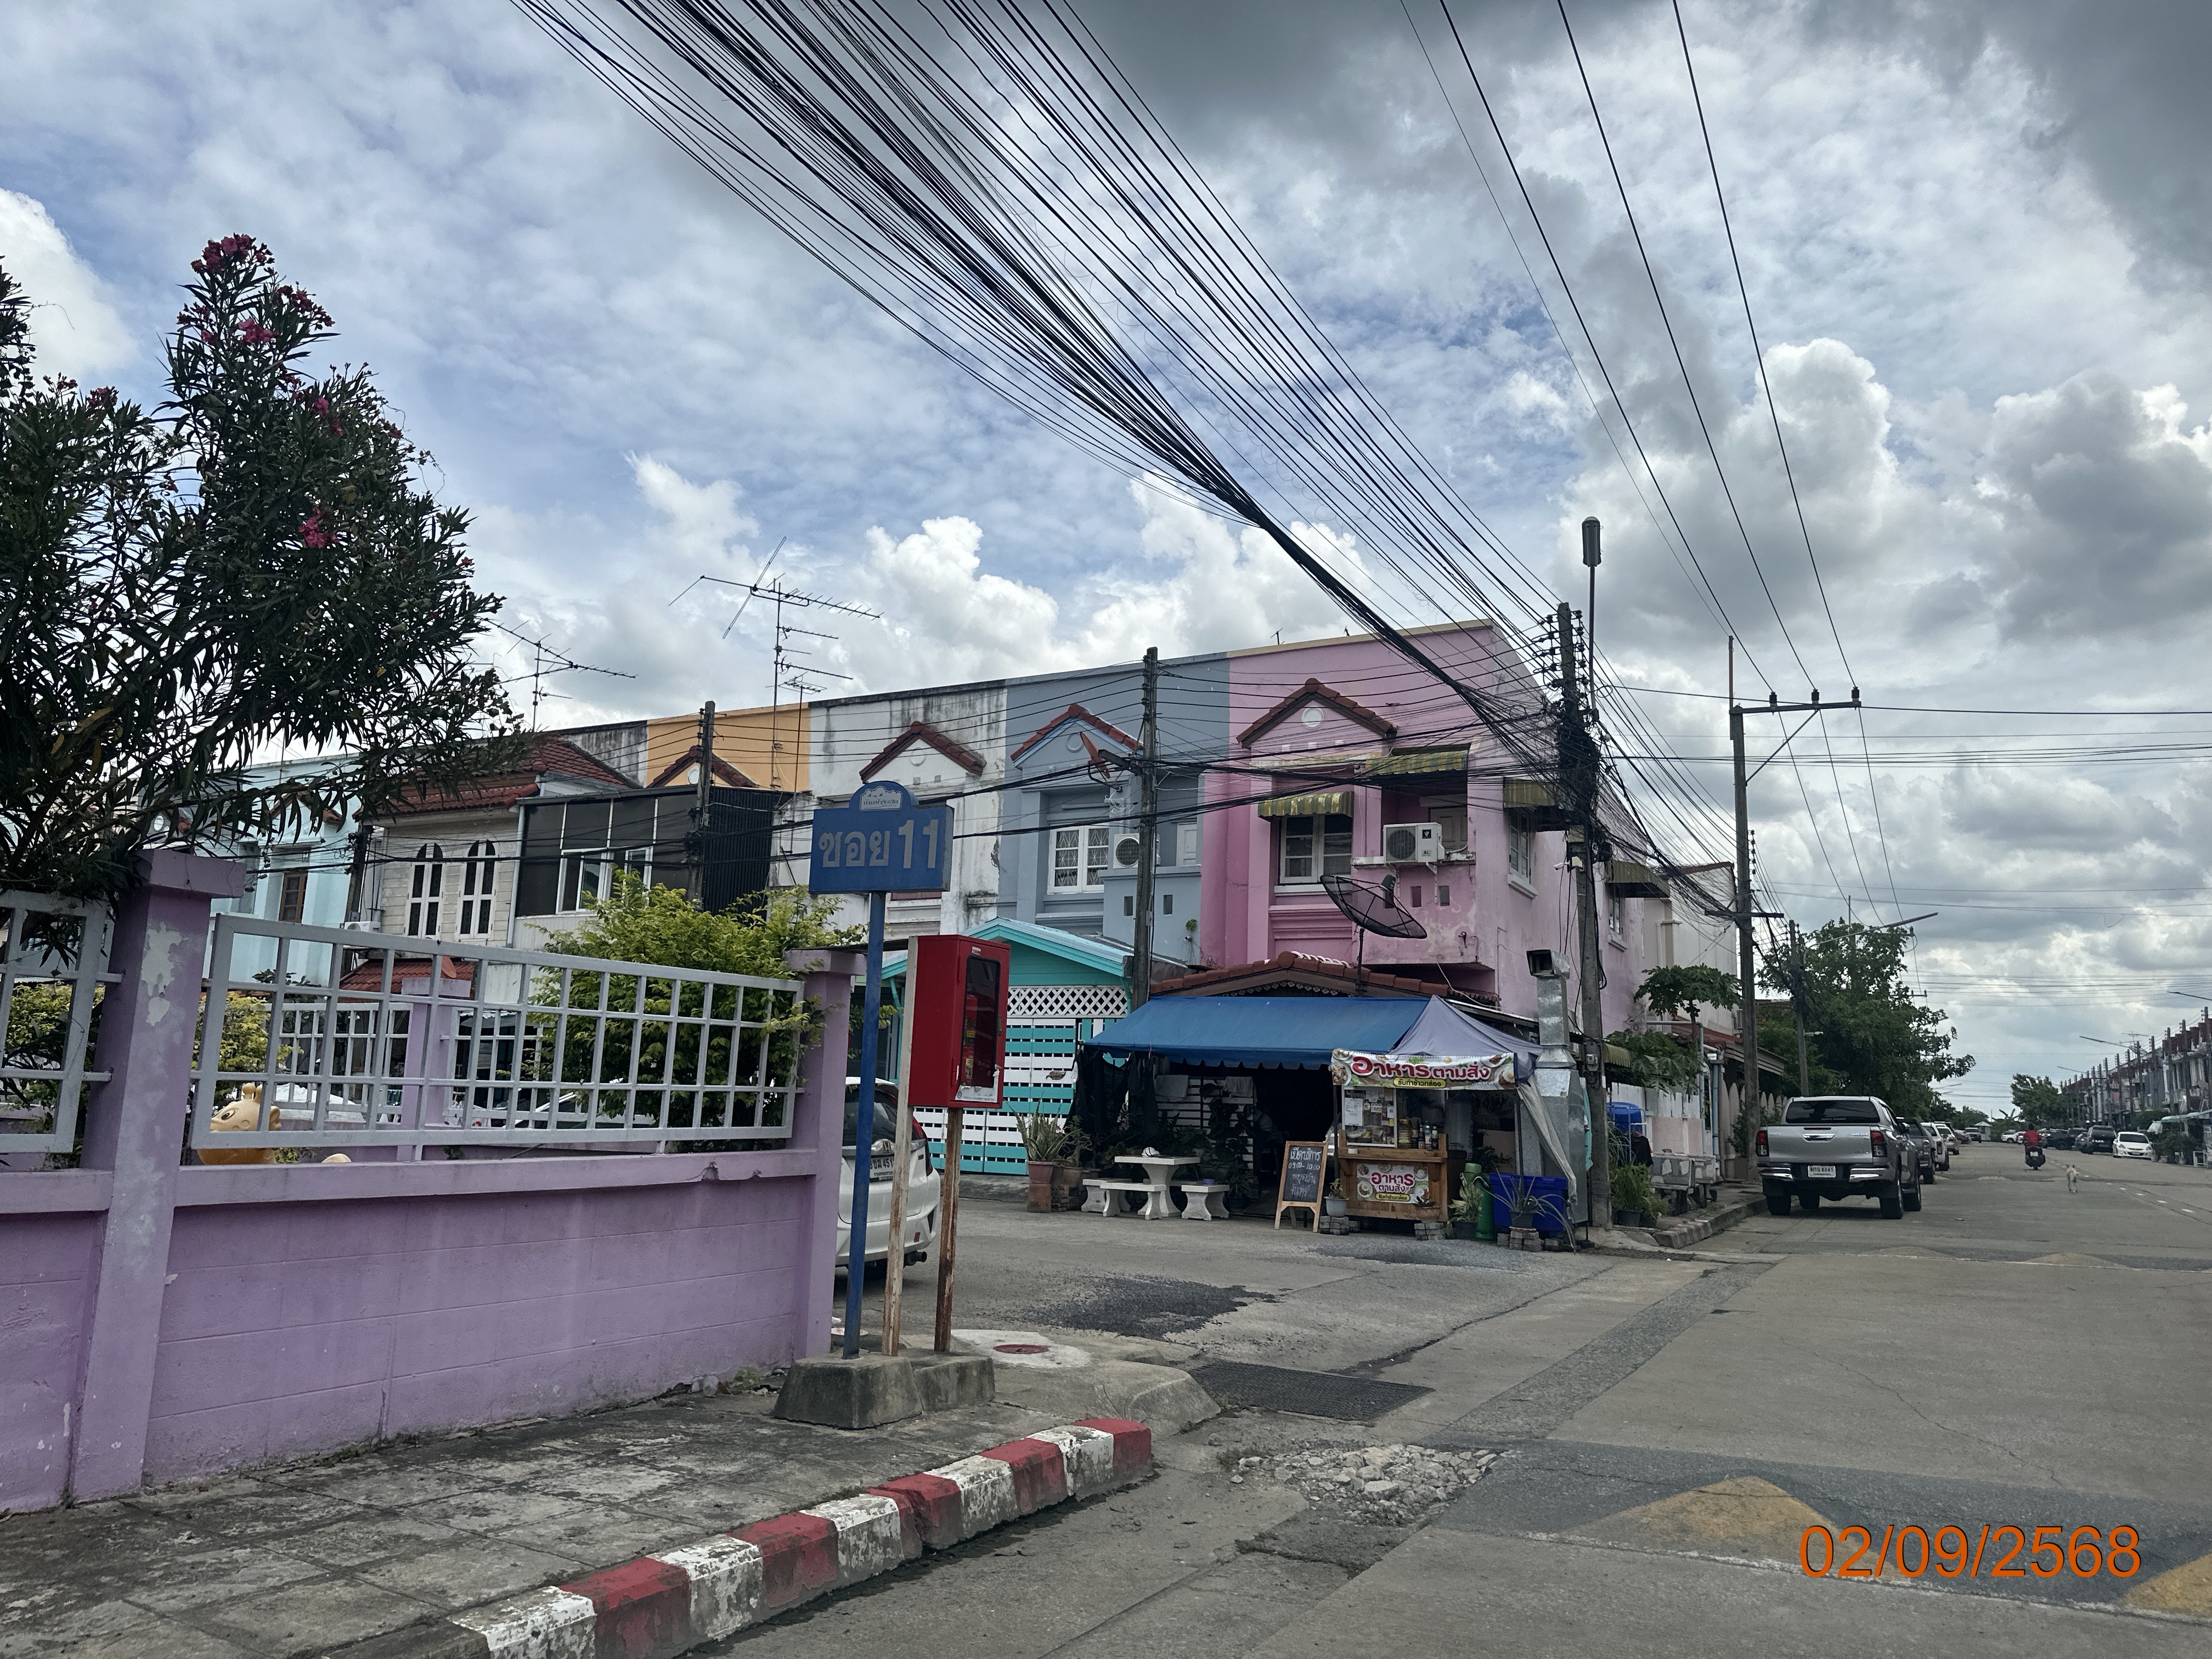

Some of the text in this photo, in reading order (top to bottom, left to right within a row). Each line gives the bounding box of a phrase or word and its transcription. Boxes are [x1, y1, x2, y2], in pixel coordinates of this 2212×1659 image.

[819, 819, 939, 869] ซอย 11
[1372, 1172, 1414, 1186] อาหาร
[1379, 1181, 1406, 1193] ตามสั่ง
